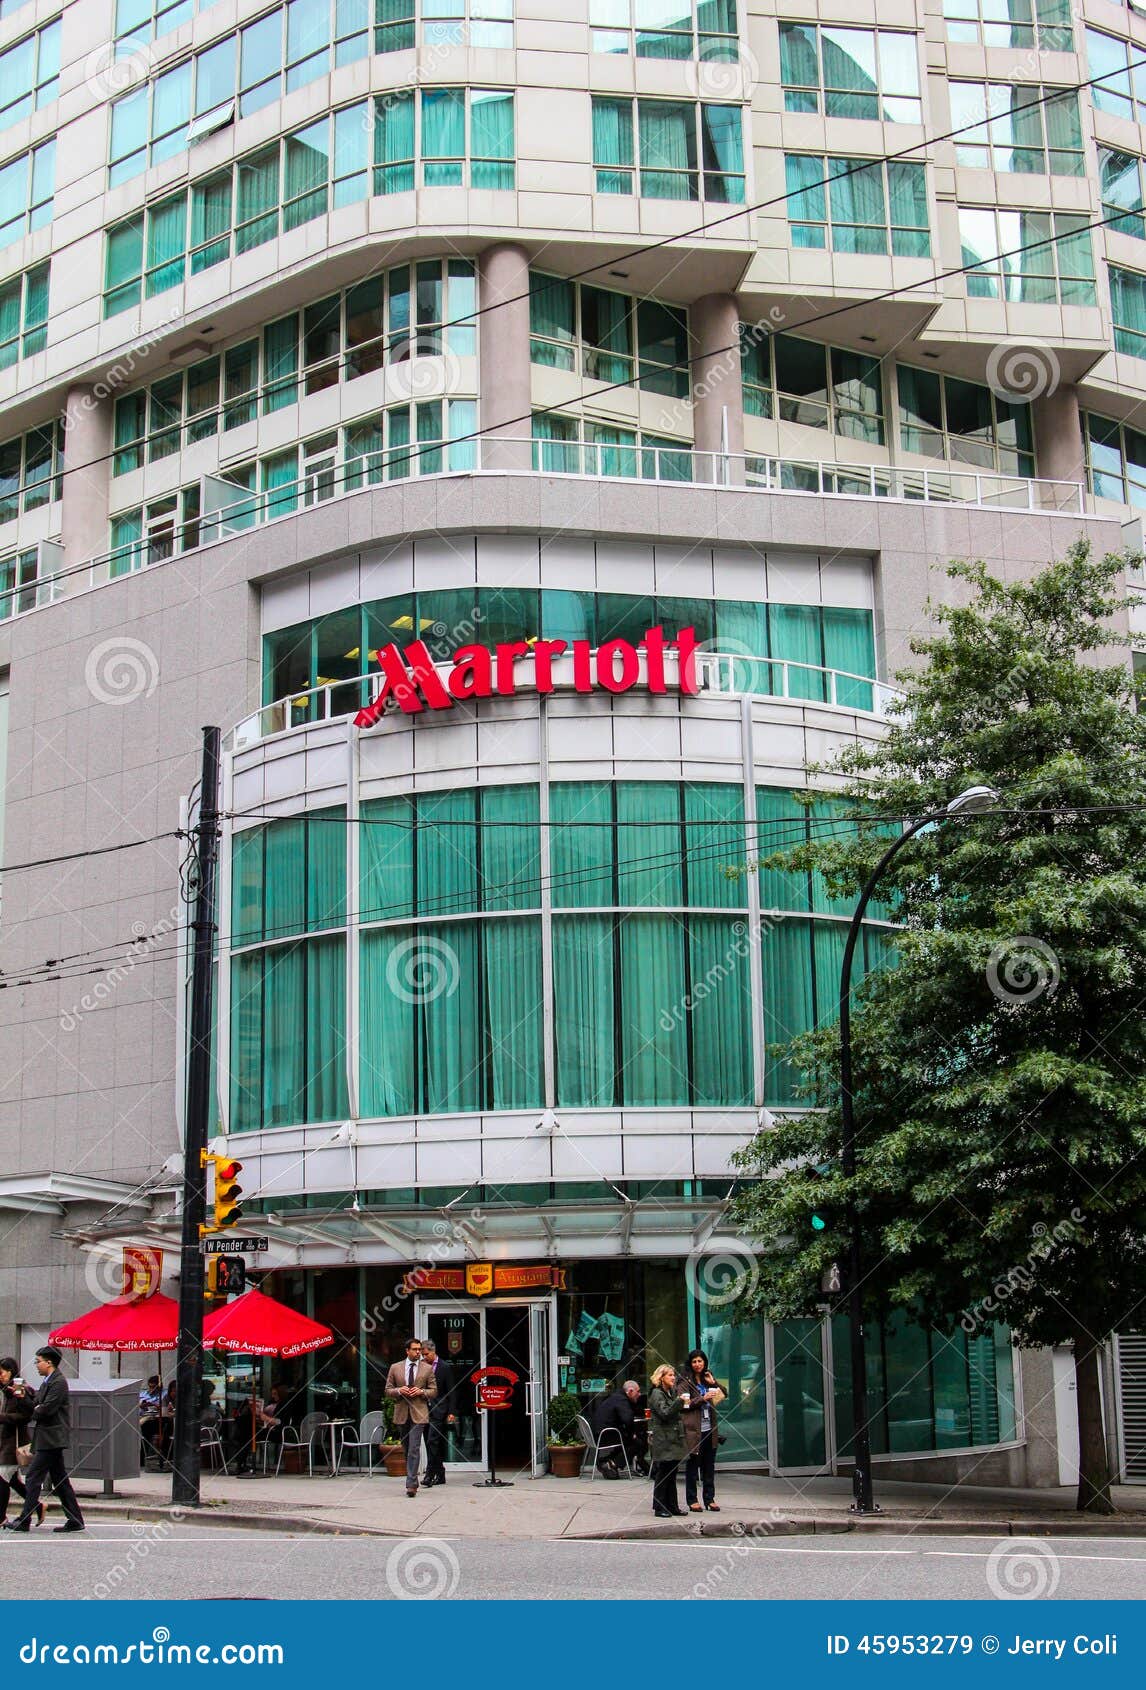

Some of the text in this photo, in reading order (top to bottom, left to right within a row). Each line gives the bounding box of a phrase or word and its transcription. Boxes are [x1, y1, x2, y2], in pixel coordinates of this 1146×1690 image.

[353, 625, 699, 728] Marriott
[207, 1241, 215, 1252] W
[216, 1239, 244, 1252] Pender
[442, 1318, 465, 1328] 1101
[116, 1340, 174, 1350] Caffè Artigiano
[217, 1336, 240, 1349] Caffè
[240, 1341, 278, 1353] Artigiano
[301, 1335, 332, 1350] Artigiano
